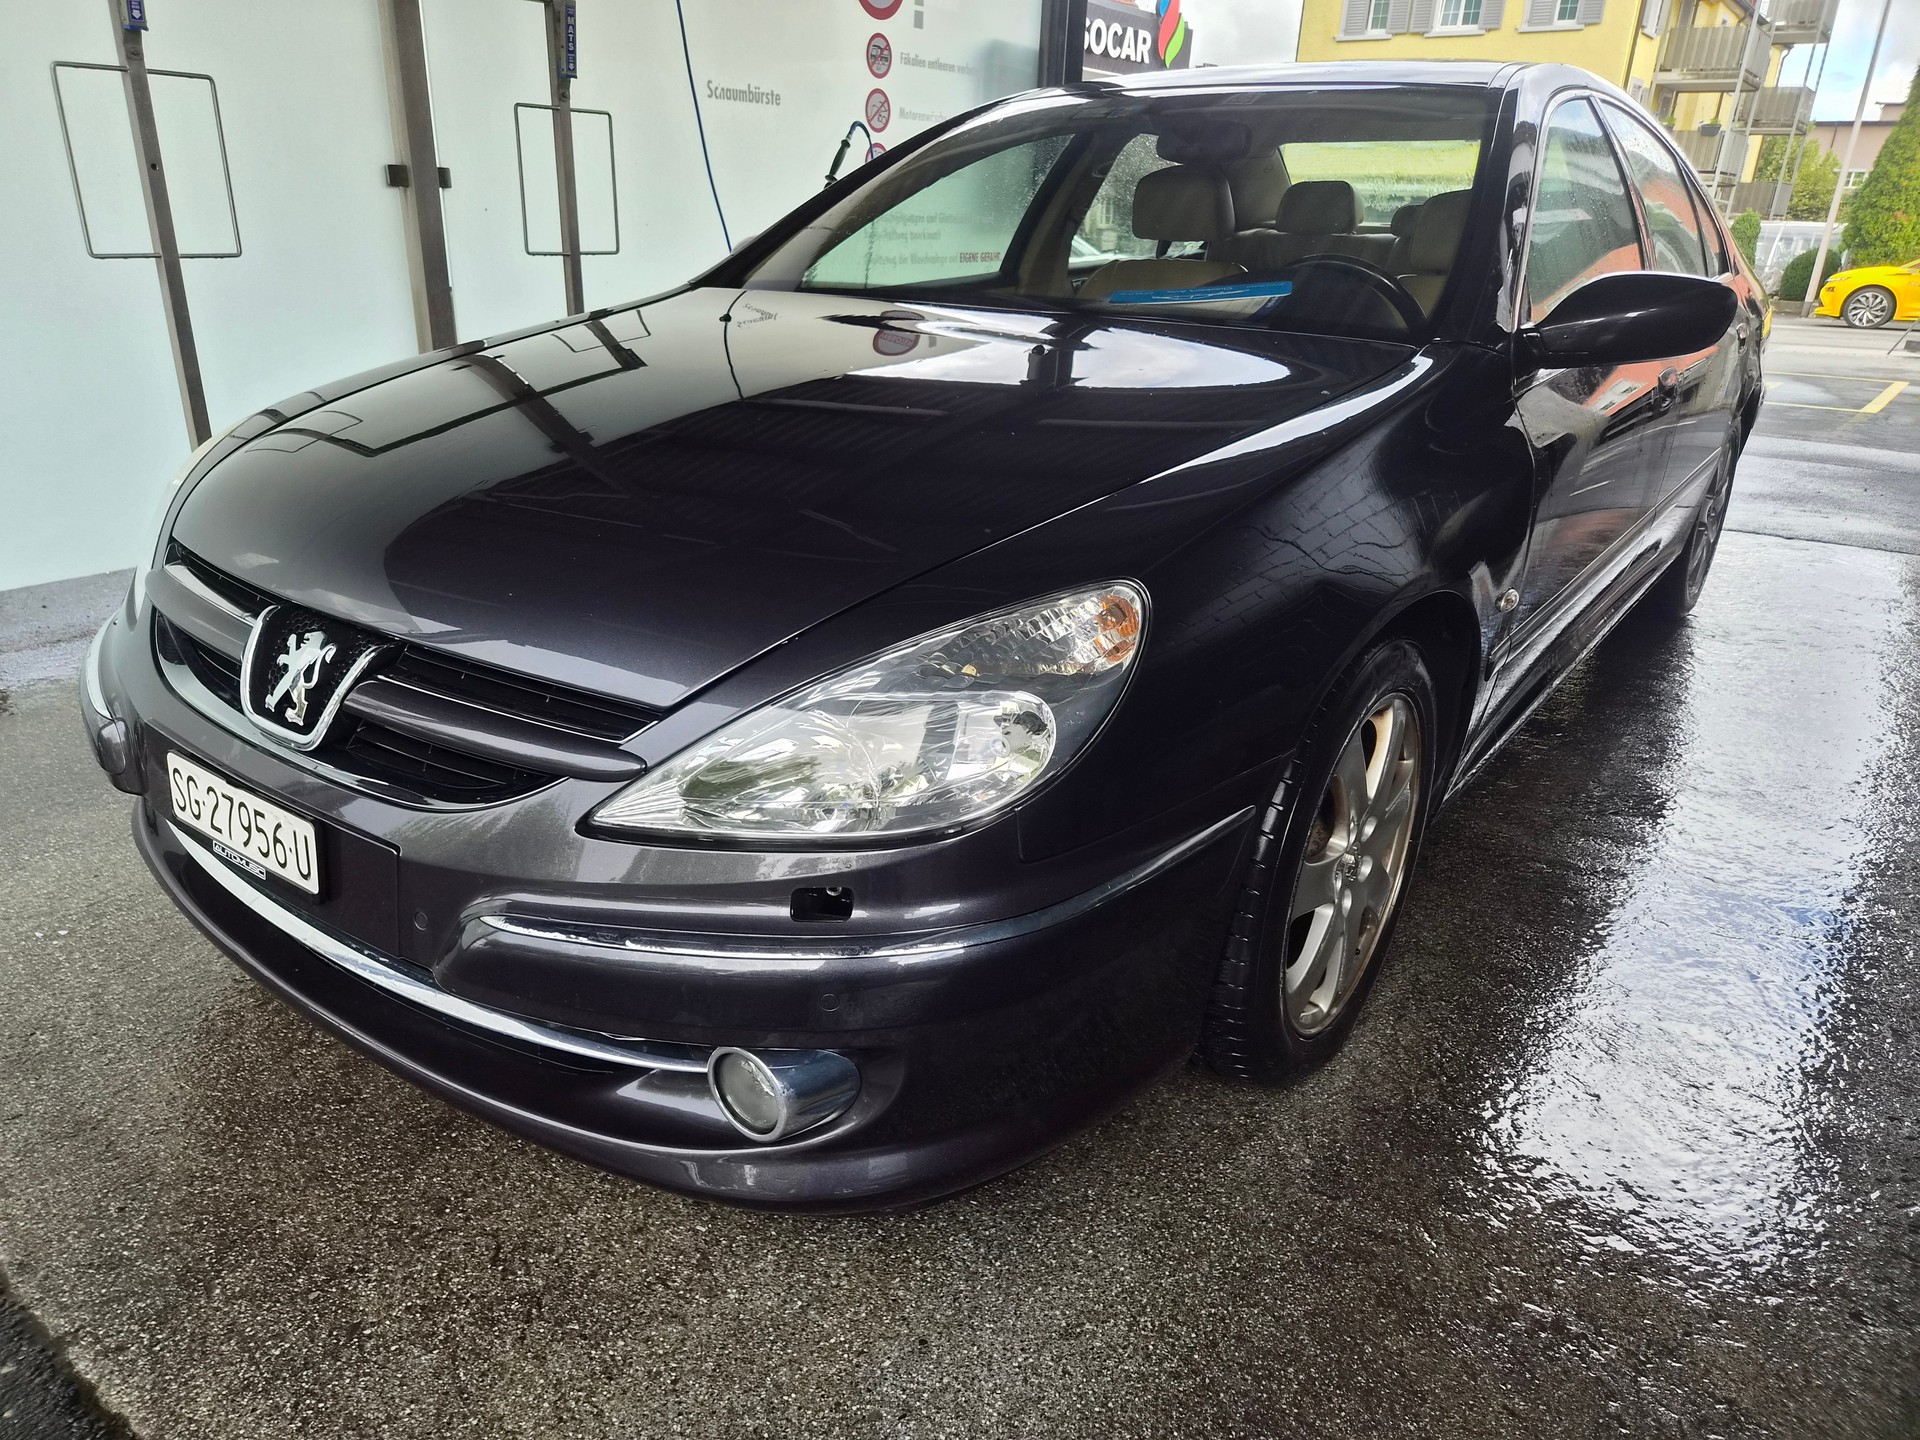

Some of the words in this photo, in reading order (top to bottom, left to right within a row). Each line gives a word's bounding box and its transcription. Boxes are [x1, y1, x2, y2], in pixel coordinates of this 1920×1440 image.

[567, 16, 575, 51] MATS
[927, 57, 956, 72] entleeren
[959, 252, 979, 264] EIGENE
